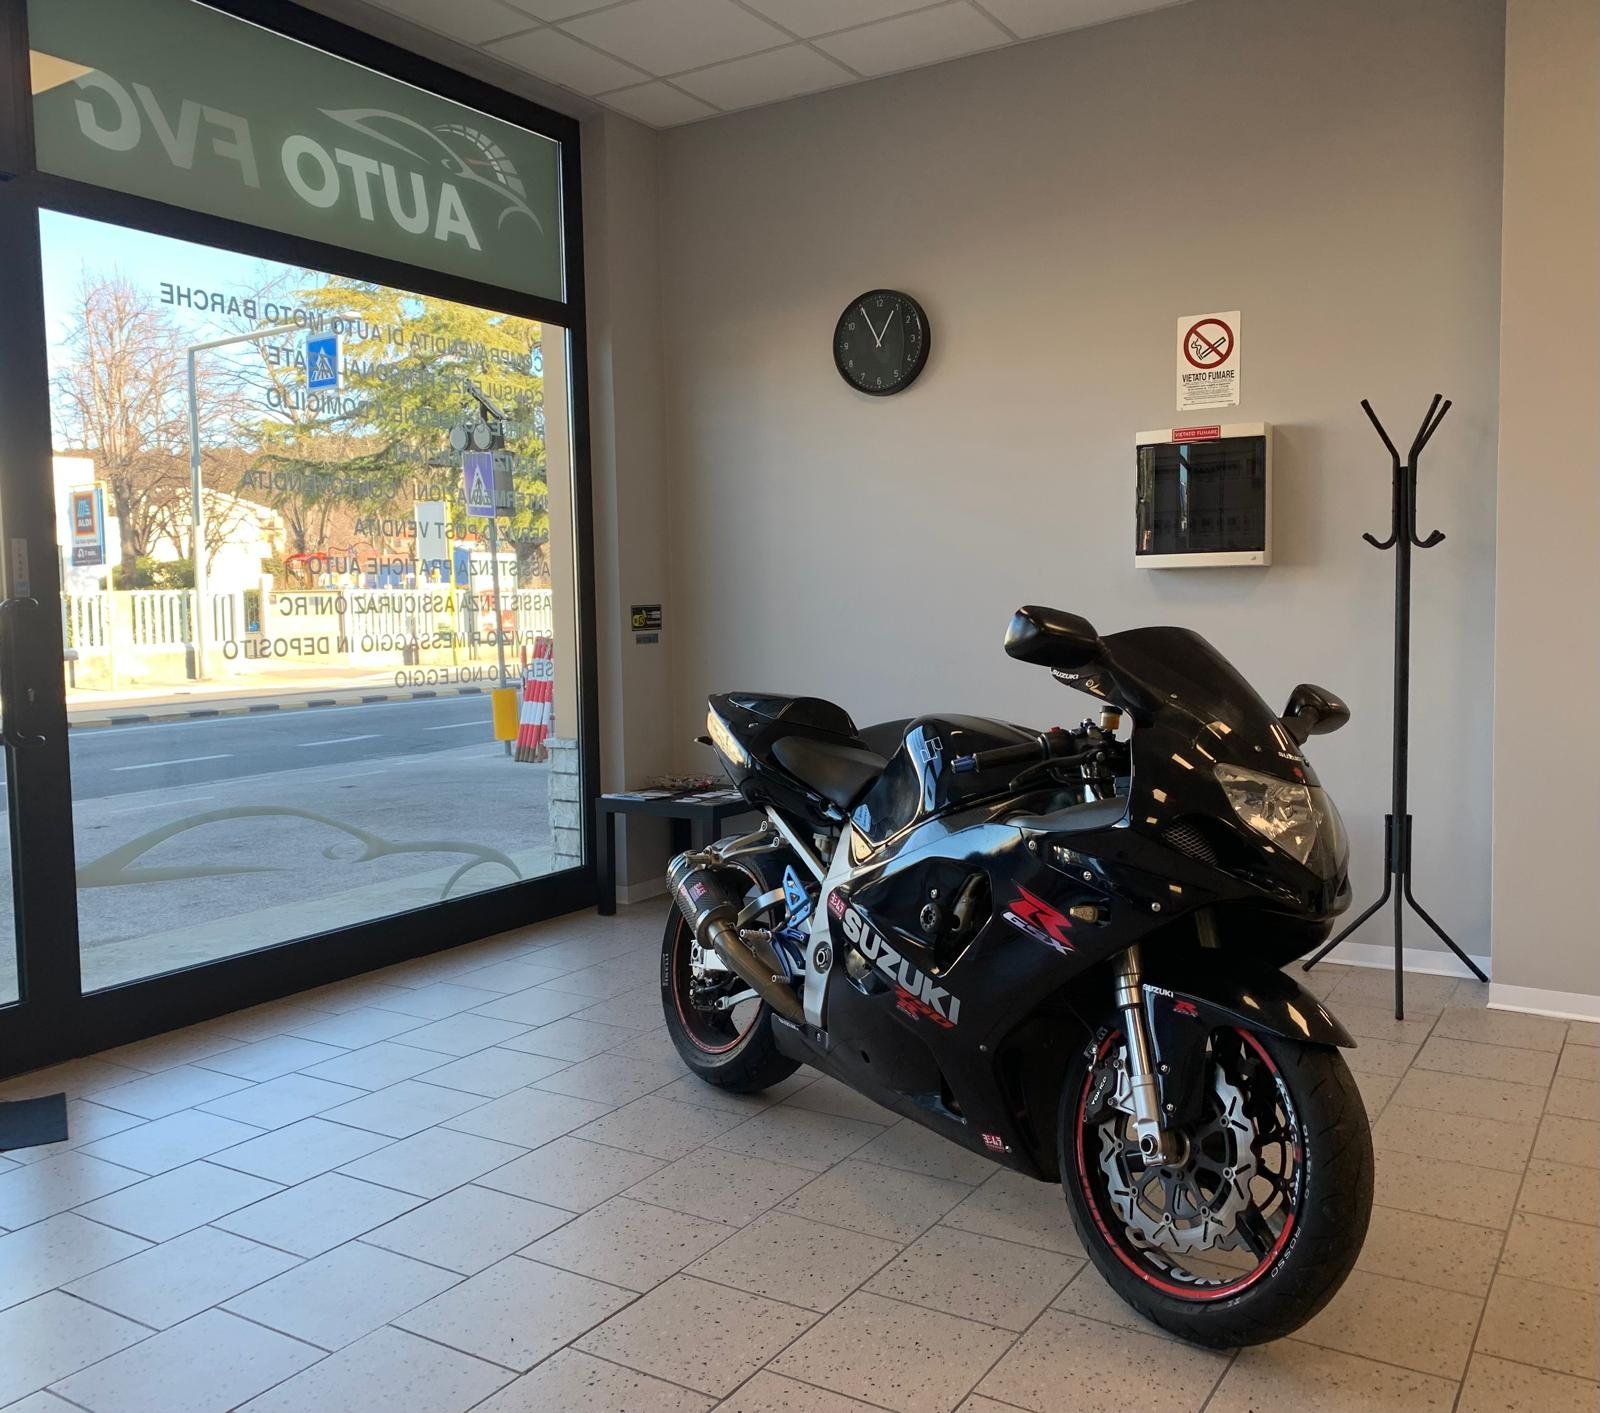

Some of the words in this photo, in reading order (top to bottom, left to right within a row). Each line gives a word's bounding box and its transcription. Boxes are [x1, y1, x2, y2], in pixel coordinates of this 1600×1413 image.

[905, 315, 911, 324] 2
[910, 334, 916, 343] 3
[843, 342, 849, 350] 9
[848, 359, 854, 368] 8
[860, 372, 866, 381] 7
[893, 369, 899, 378] 5
[1182, 372, 1207, 383] VIETATO
[1208, 370, 1235, 381] FUMARE
[876, 376, 882, 386] 6
[1174, 430, 1196, 438] VIETATO
[77, 519, 92, 527] ALDI
[1052, 669, 1079, 680] SUZUKI
[843, 908, 960, 1025] SUZUKI
[1142, 983, 1174, 998] SUZUKI
[1303, 1124, 1311, 1199] DIABLO
[1271, 1226, 1301, 1278] ROSSO
